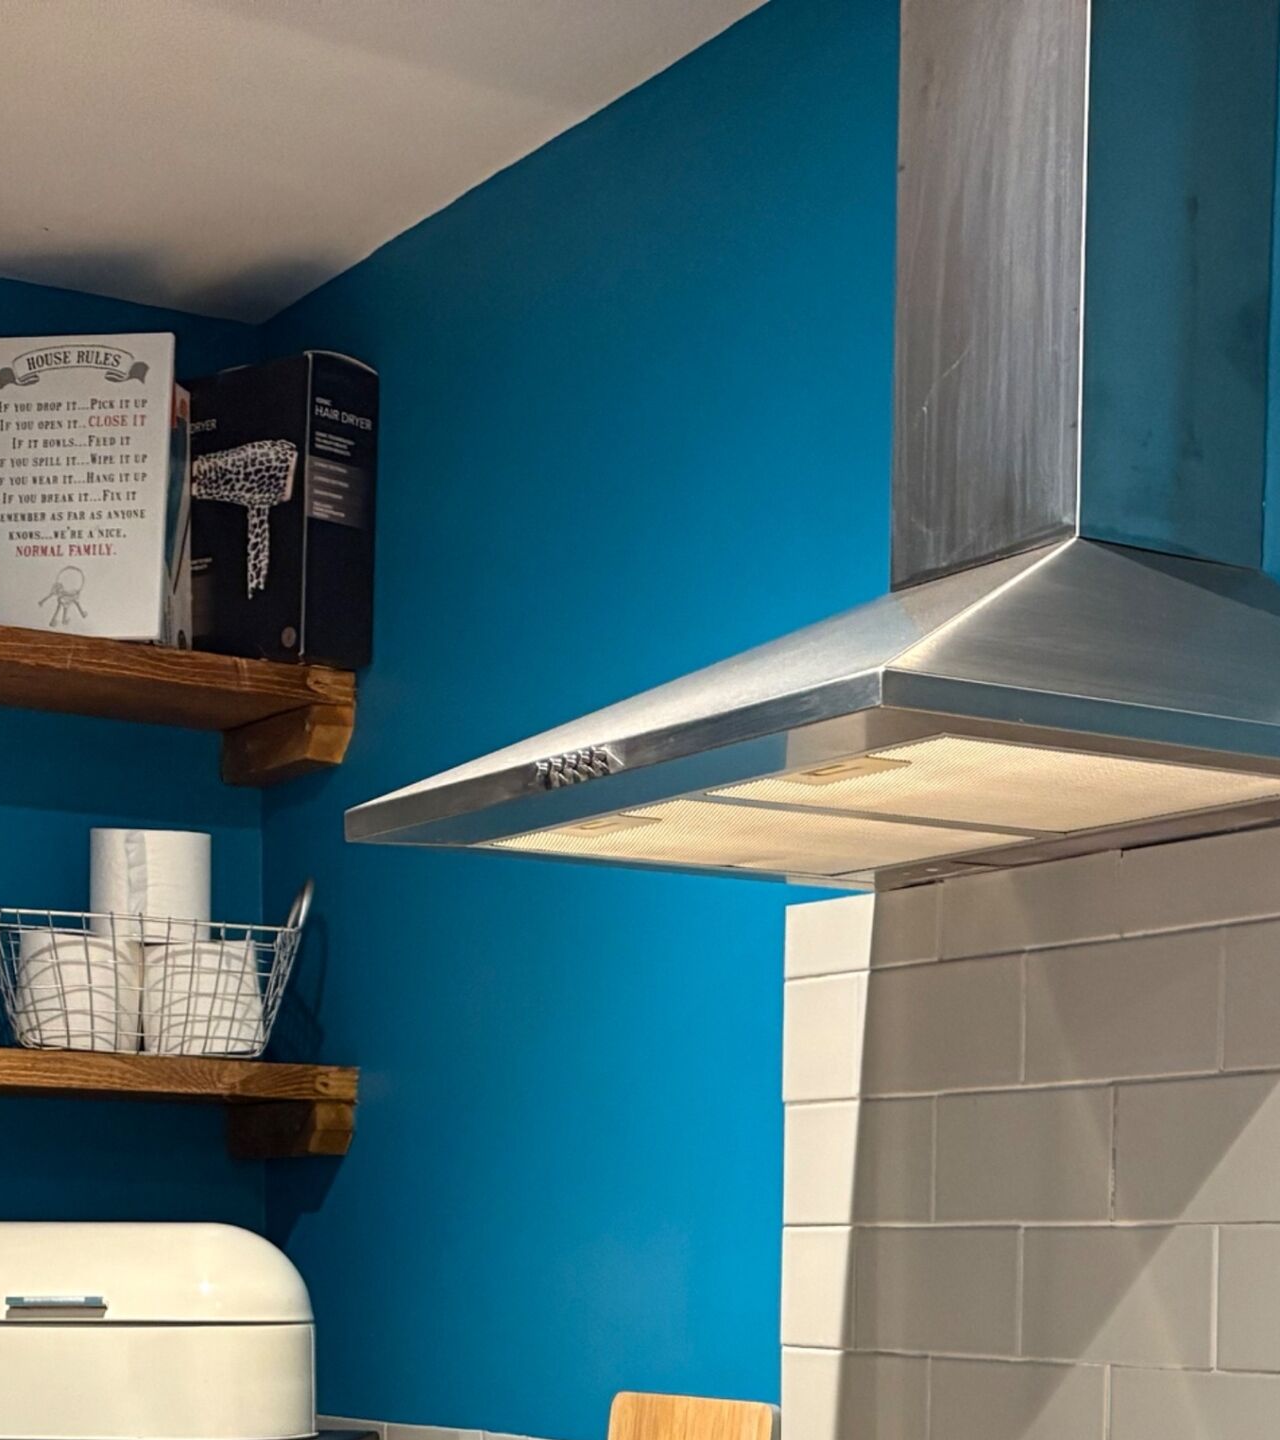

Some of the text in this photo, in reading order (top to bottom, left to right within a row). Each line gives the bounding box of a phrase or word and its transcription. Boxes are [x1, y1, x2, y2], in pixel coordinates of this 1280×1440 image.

[26, 350, 122, 371] HOUSE RULES
[133, 414, 147, 427] IT
[314, 405, 373, 431] HAIR DRYER
[15, 545, 64, 558] NORMAL
